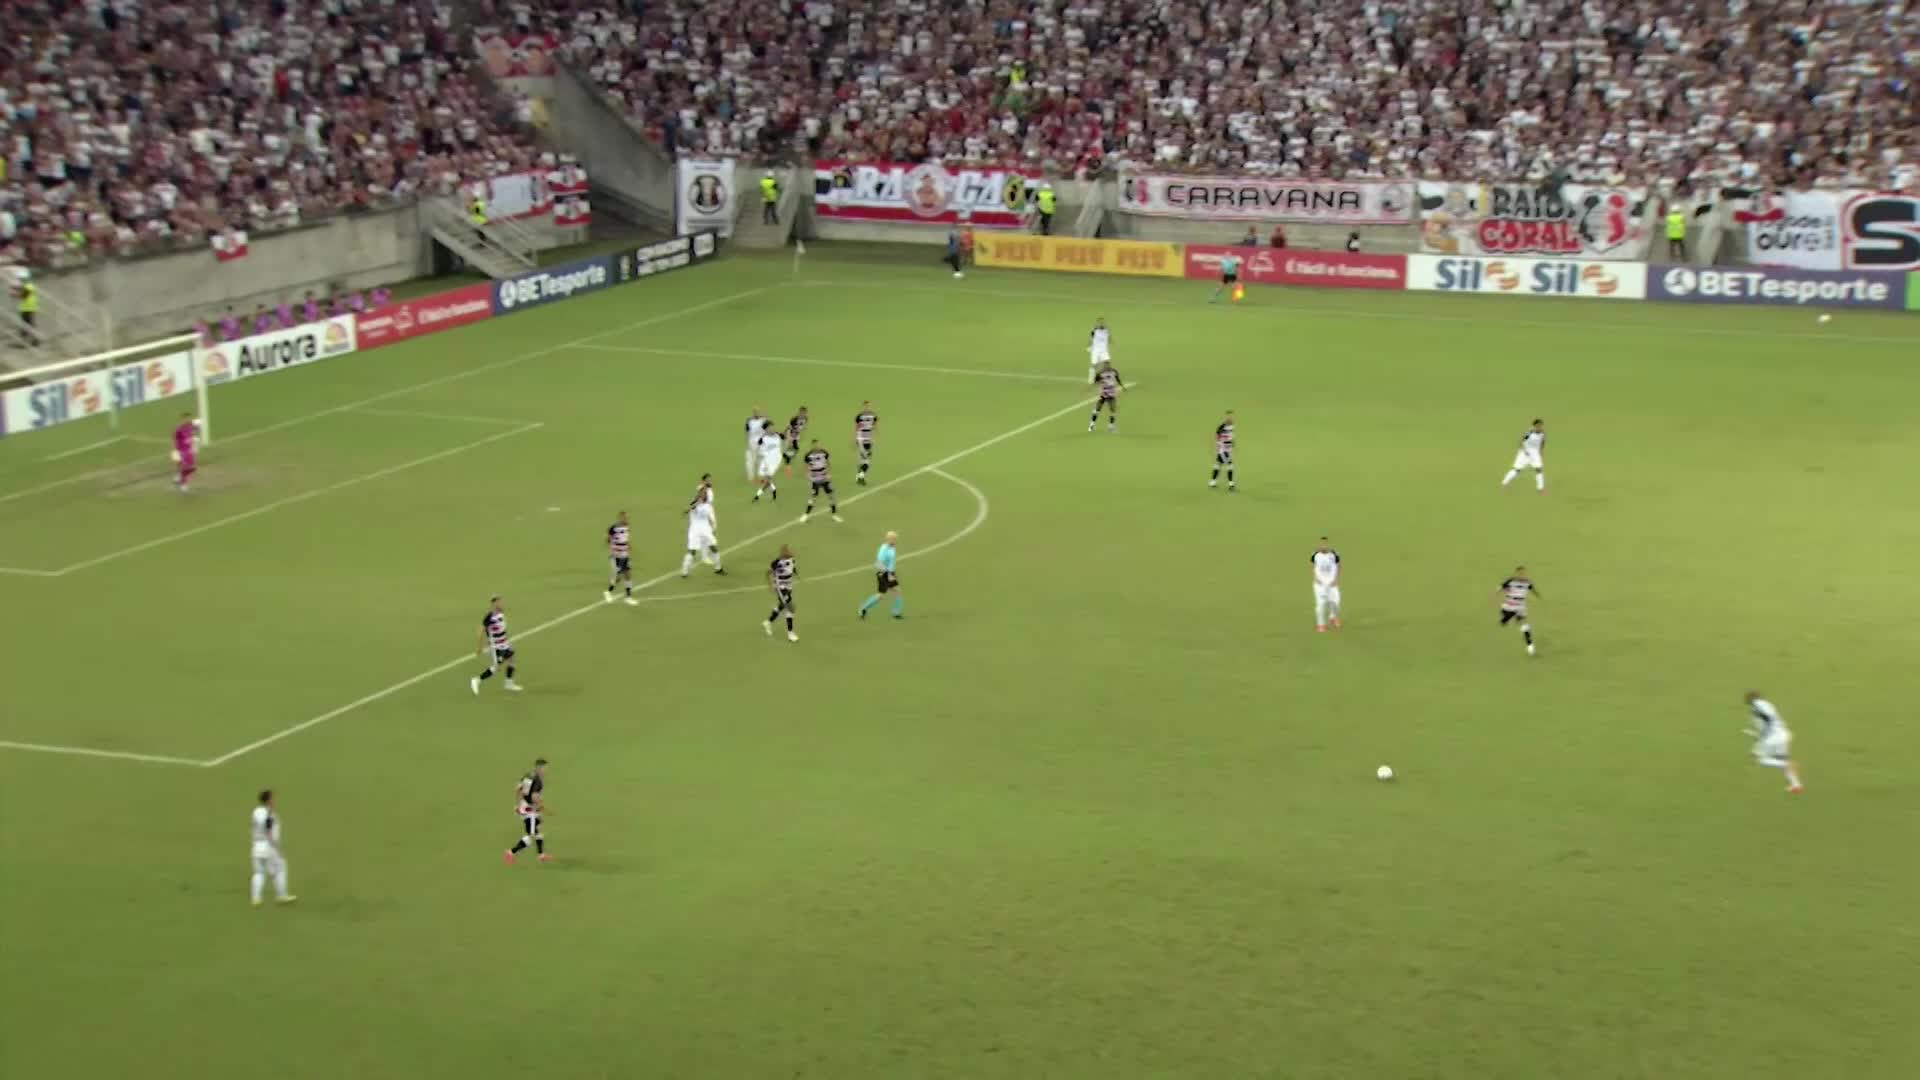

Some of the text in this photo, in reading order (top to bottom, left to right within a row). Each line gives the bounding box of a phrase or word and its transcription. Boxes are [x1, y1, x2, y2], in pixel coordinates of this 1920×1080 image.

[1167, 184, 1360, 209] CARAVANA
[1478, 219, 1582, 252] CORAL
[517, 264, 606, 303] BETesporte
[1436, 259, 1481, 290] Sil
[1530, 262, 1578, 294] Sil
[1699, 272, 1888, 304] BETesporte
[238, 333, 316, 375] Aurora
[110, 365, 144, 409] Sil
[30, 384, 68, 427] Sil
